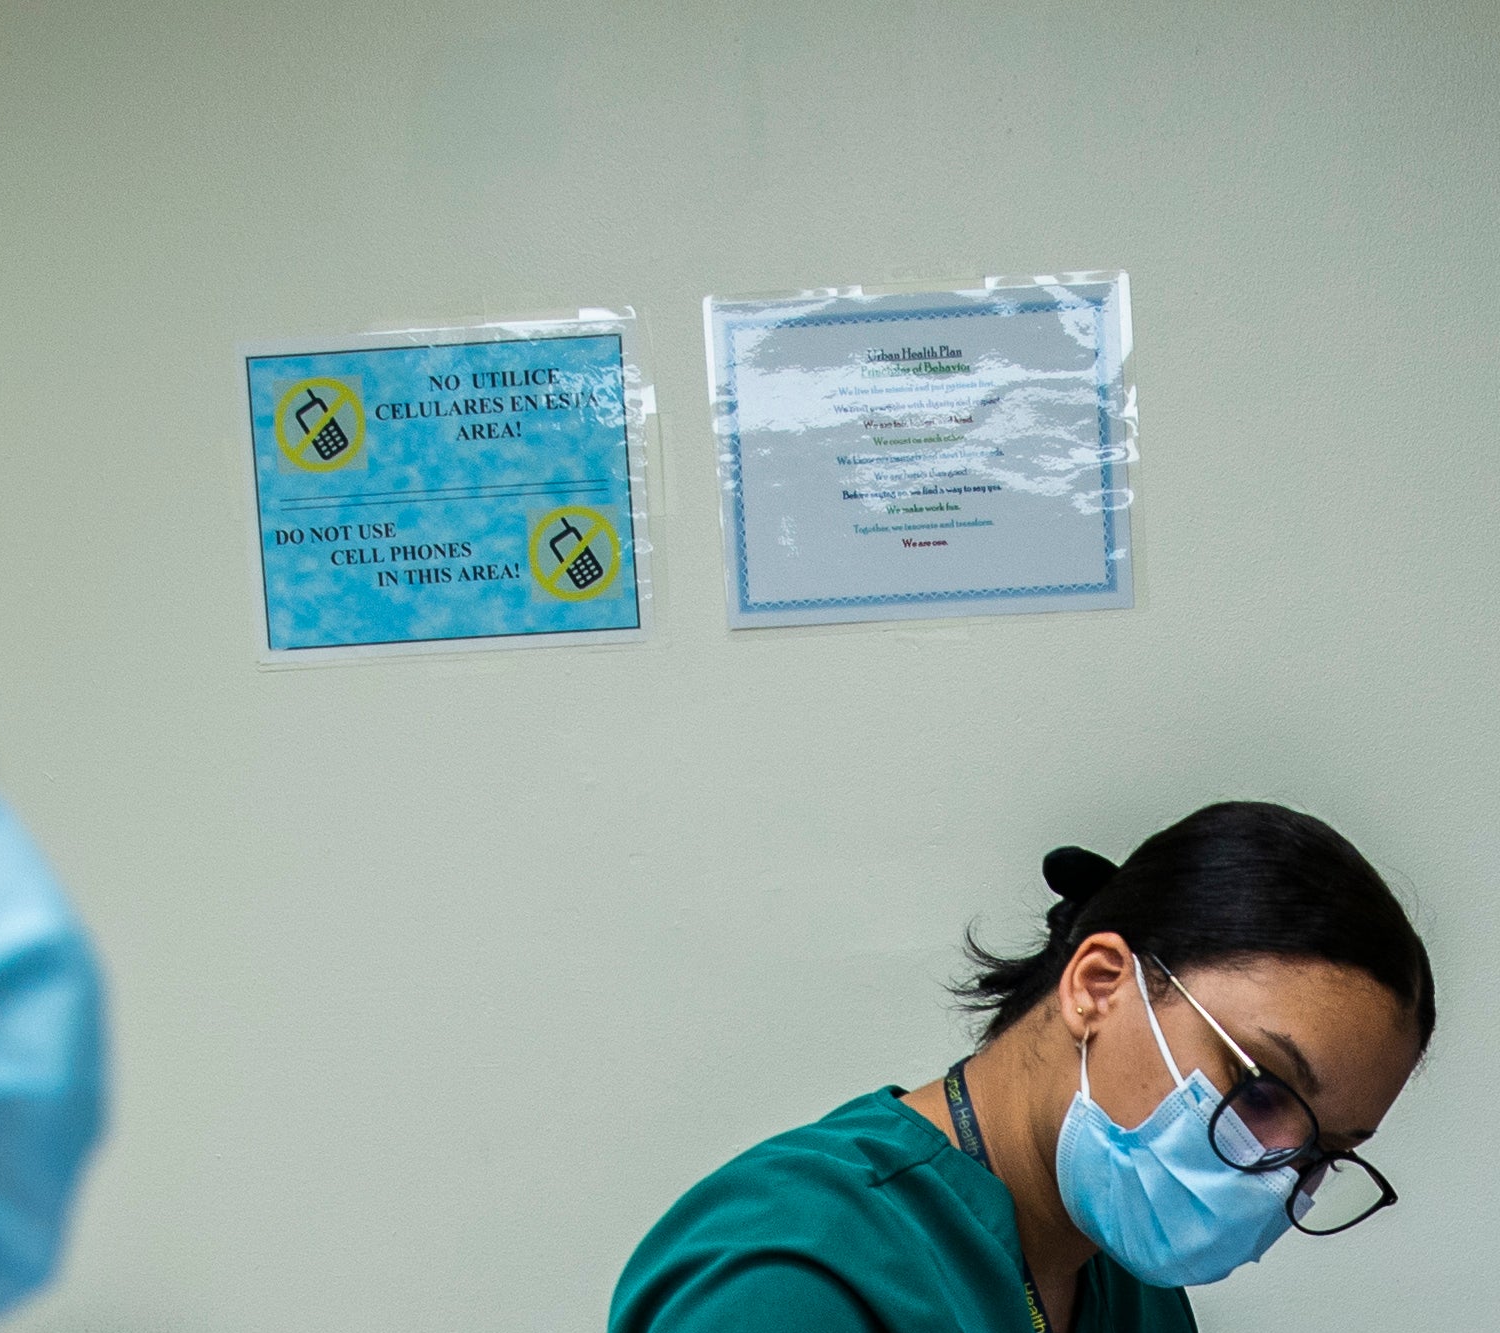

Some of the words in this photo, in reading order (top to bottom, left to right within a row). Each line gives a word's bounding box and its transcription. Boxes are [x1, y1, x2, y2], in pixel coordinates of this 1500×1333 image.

[866, 349, 900, 362] Urban
[901, 346, 938, 360] Health
[939, 345, 963, 358] Plan
[428, 374, 461, 392] NO
[472, 367, 561, 389] UTILICE
[911, 362, 922, 376] of
[923, 360, 971, 374] Behavior
[375, 392, 504, 421] CELULARES
[510, 393, 539, 412] EN
[546, 391, 600, 411] ESTA
[455, 421, 522, 442] AREA!
[275, 527, 305, 546] DO
[310, 524, 353, 544] NOT
[359, 522, 397, 540] USE
[902, 538, 918, 548] We
[330, 546, 385, 567] CELL
[390, 541, 473, 563] PHONES
[377, 569, 399, 587] IN
[403, 566, 452, 586] THIS
[457, 562, 521, 583] AREA!
[956, 1107, 981, 1157] Health
